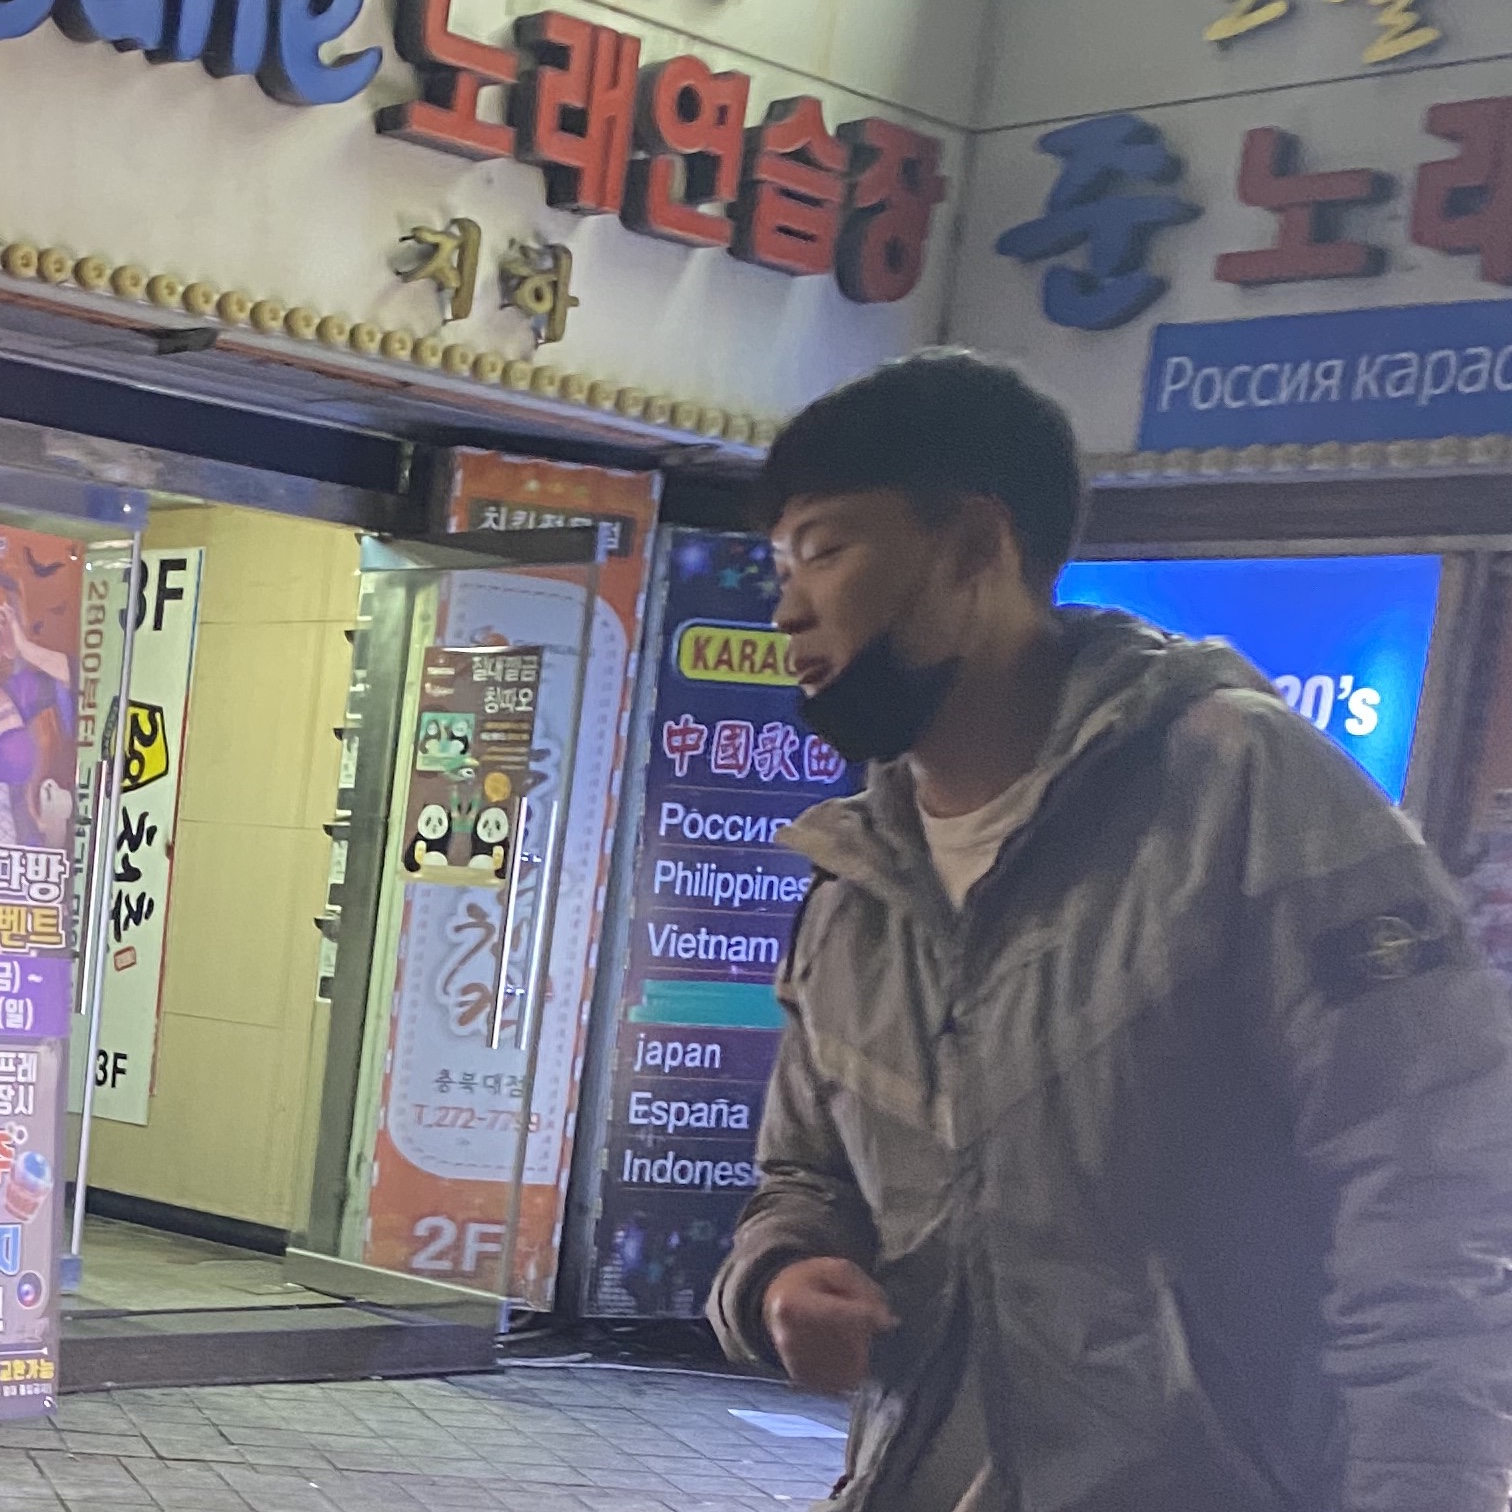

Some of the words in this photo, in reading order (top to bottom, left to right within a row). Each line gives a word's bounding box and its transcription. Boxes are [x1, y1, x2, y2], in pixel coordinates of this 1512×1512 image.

[376, 0, 948, 304] 노래연습장
[393, 217, 579, 346] 지하
[1157, 354, 1346, 412] Россия
[662, 714, 847, 784] 中國歌曲
[653, 859, 812, 907] Philippines
[647, 922, 779, 963] Vietnam
[94, 1049, 128, 1089] 3F
[633, 1033, 722, 1073] japan
[628, 1091, 750, 1134] España
[411, 1215, 507, 1272] 2F
